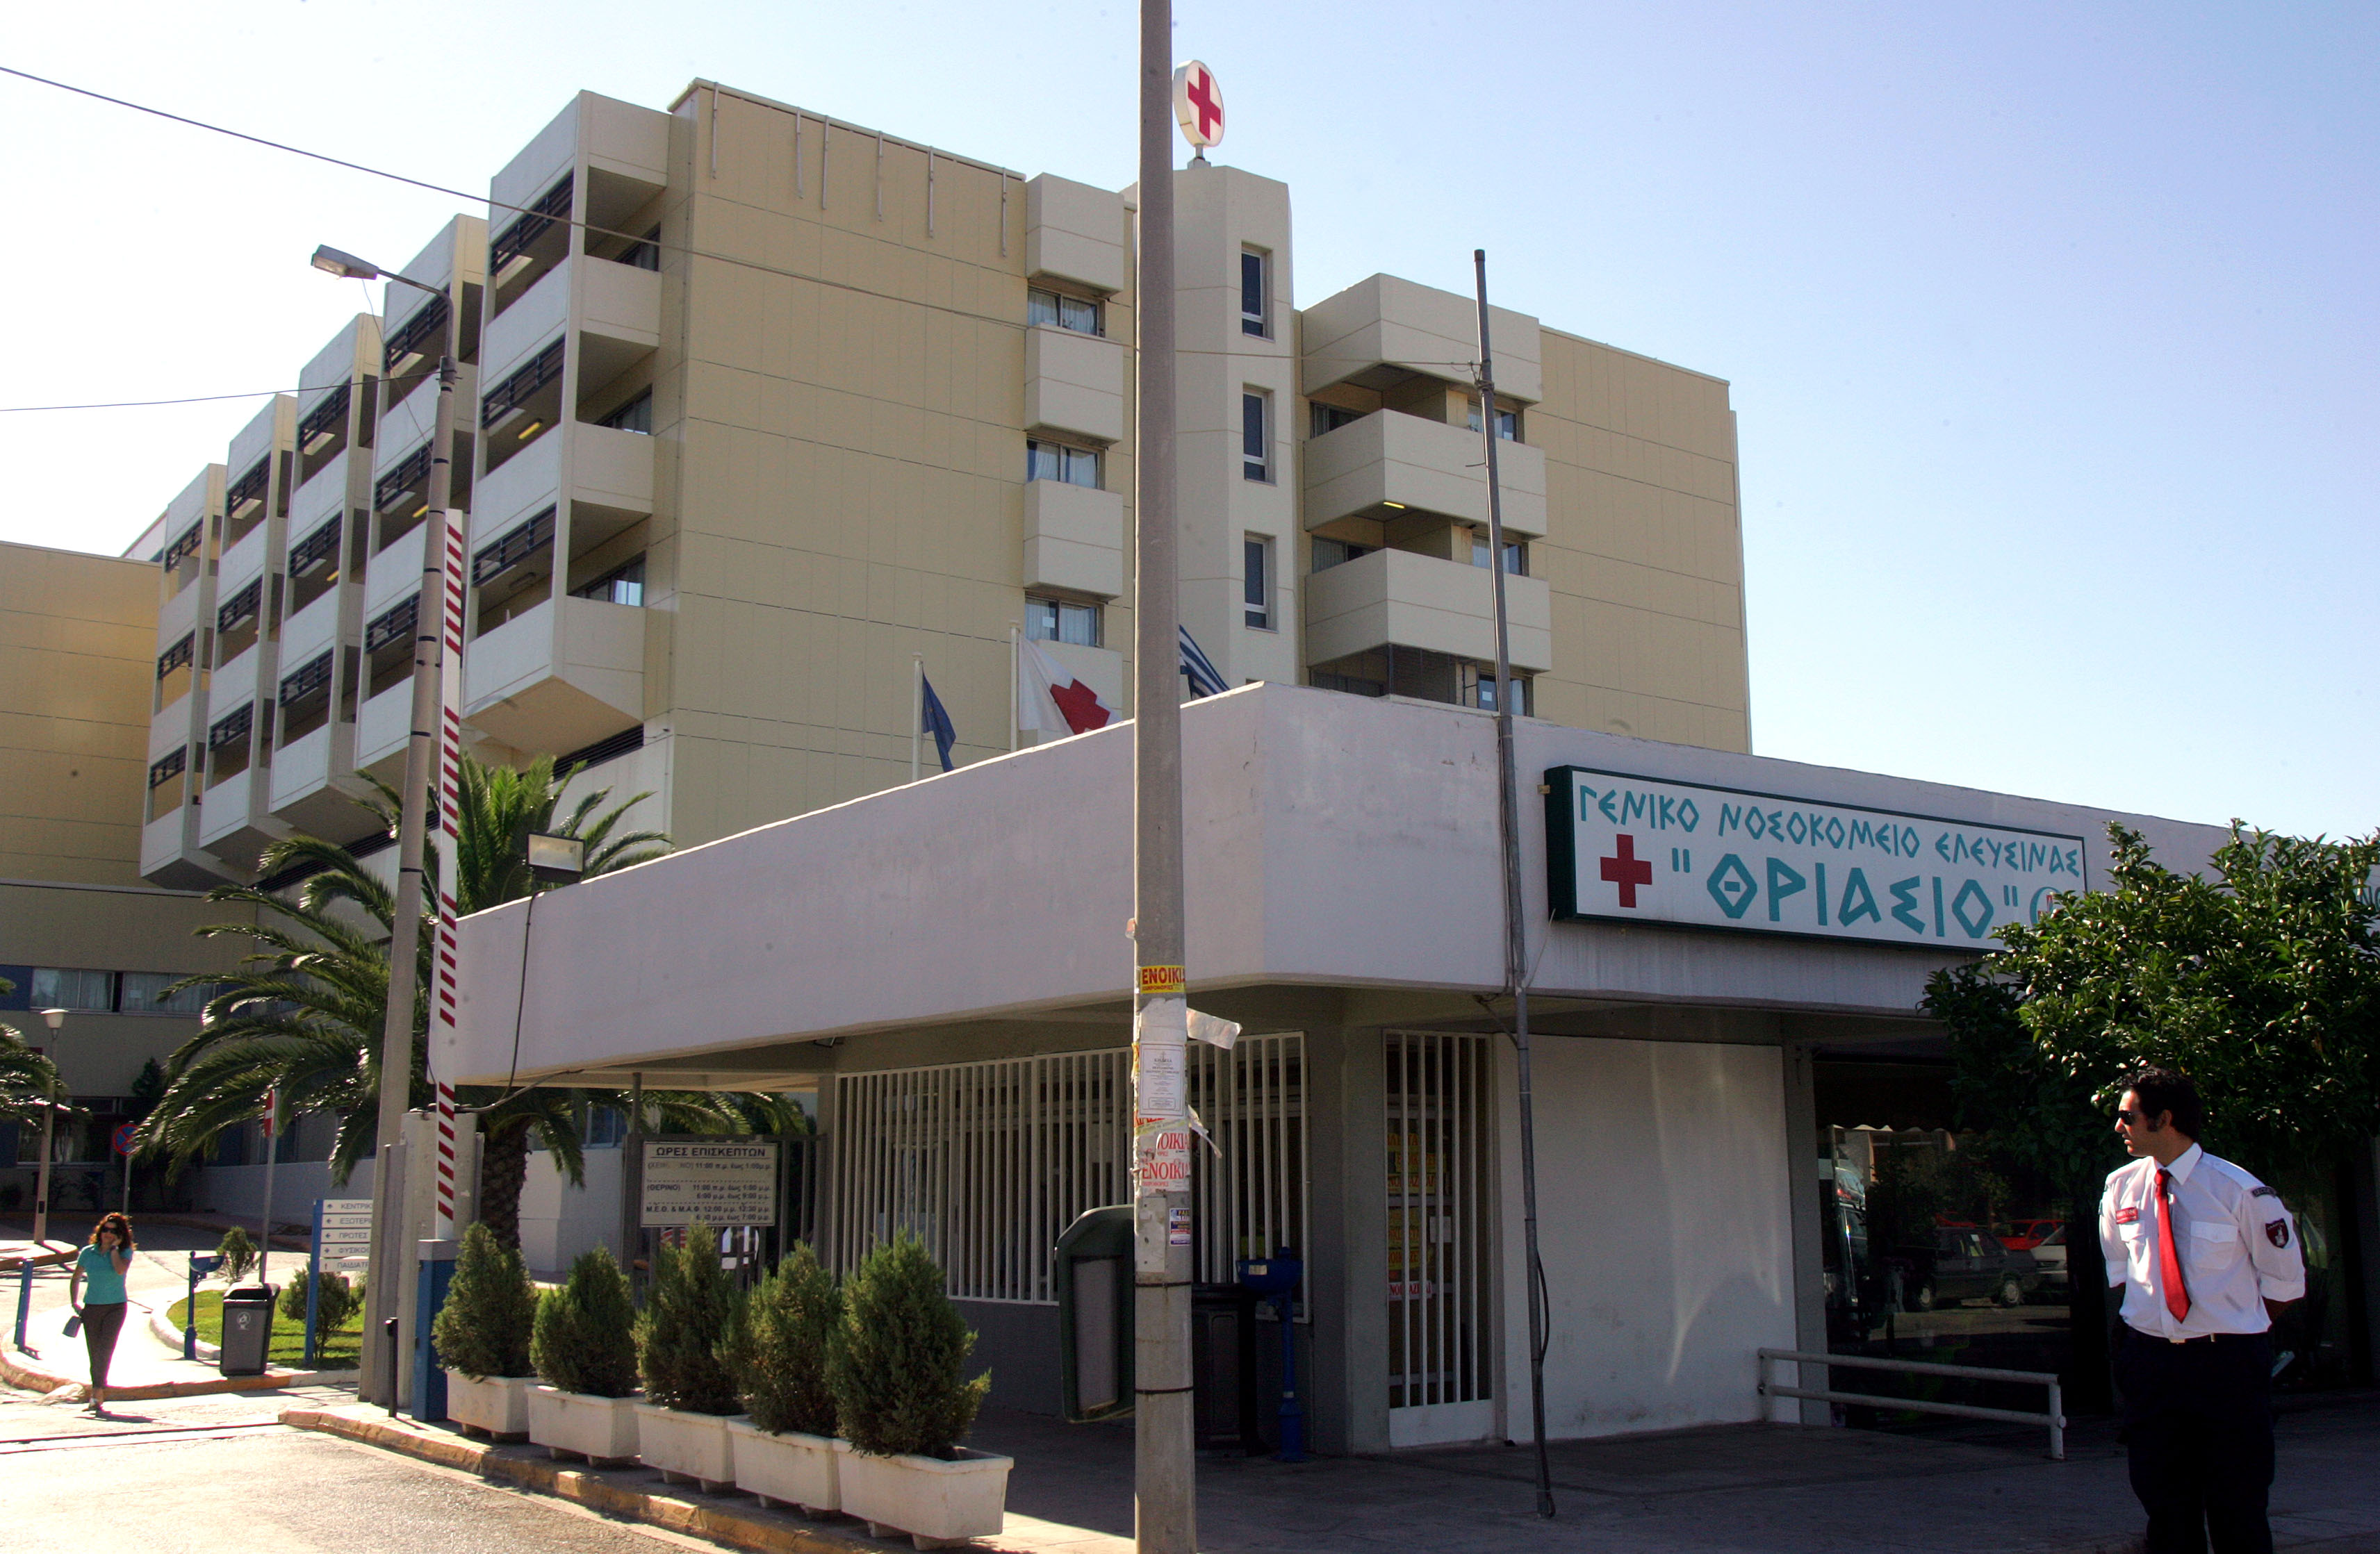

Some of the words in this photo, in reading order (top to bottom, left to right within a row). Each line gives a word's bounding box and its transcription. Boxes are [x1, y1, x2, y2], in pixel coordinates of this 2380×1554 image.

[1581, 786, 1700, 832] ΓΕΝΙΚΟ
[1719, 804, 1921, 858] ΝΟΣΟΚΟΜΕΙΟ
[1936, 834, 2081, 877] ΕΛΕΥΣΙΝΑΣ
[656, 1148, 688, 1156] ΩΡΕΣ
[692, 1148, 765, 1157] ΕΠΙΣΚΕΠΤΩΝ
